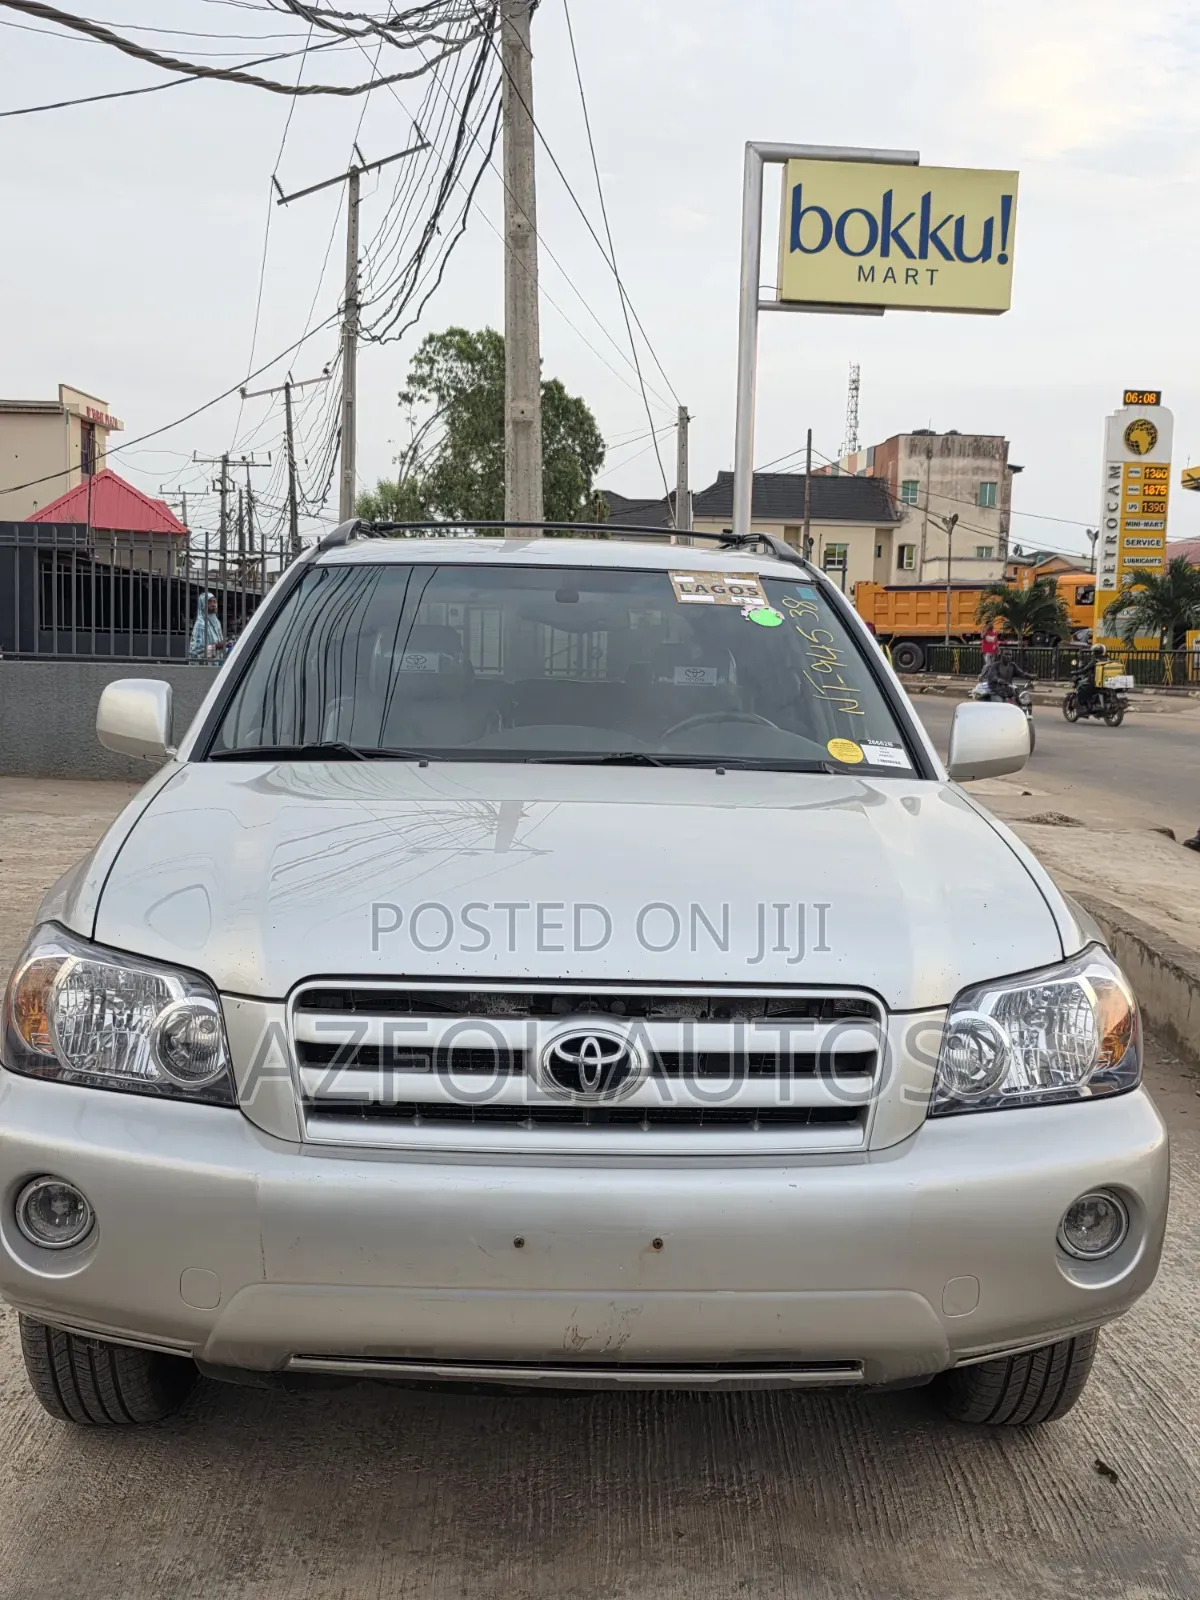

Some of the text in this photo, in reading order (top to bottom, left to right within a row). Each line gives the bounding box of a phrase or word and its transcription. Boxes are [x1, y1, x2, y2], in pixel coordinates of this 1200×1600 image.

[790, 183, 1013, 265] bokku!
[857, 264, 939, 286] MART
[1125, 391, 1156, 404] 06:08
[1143, 484, 1167, 495] 1875
[1142, 502, 1166, 513] 1390
[1102, 465, 1121, 588] PETROCAM
[1125, 520, 1164, 528] MINI-MART
[679, 582, 759, 597] LAGOS
